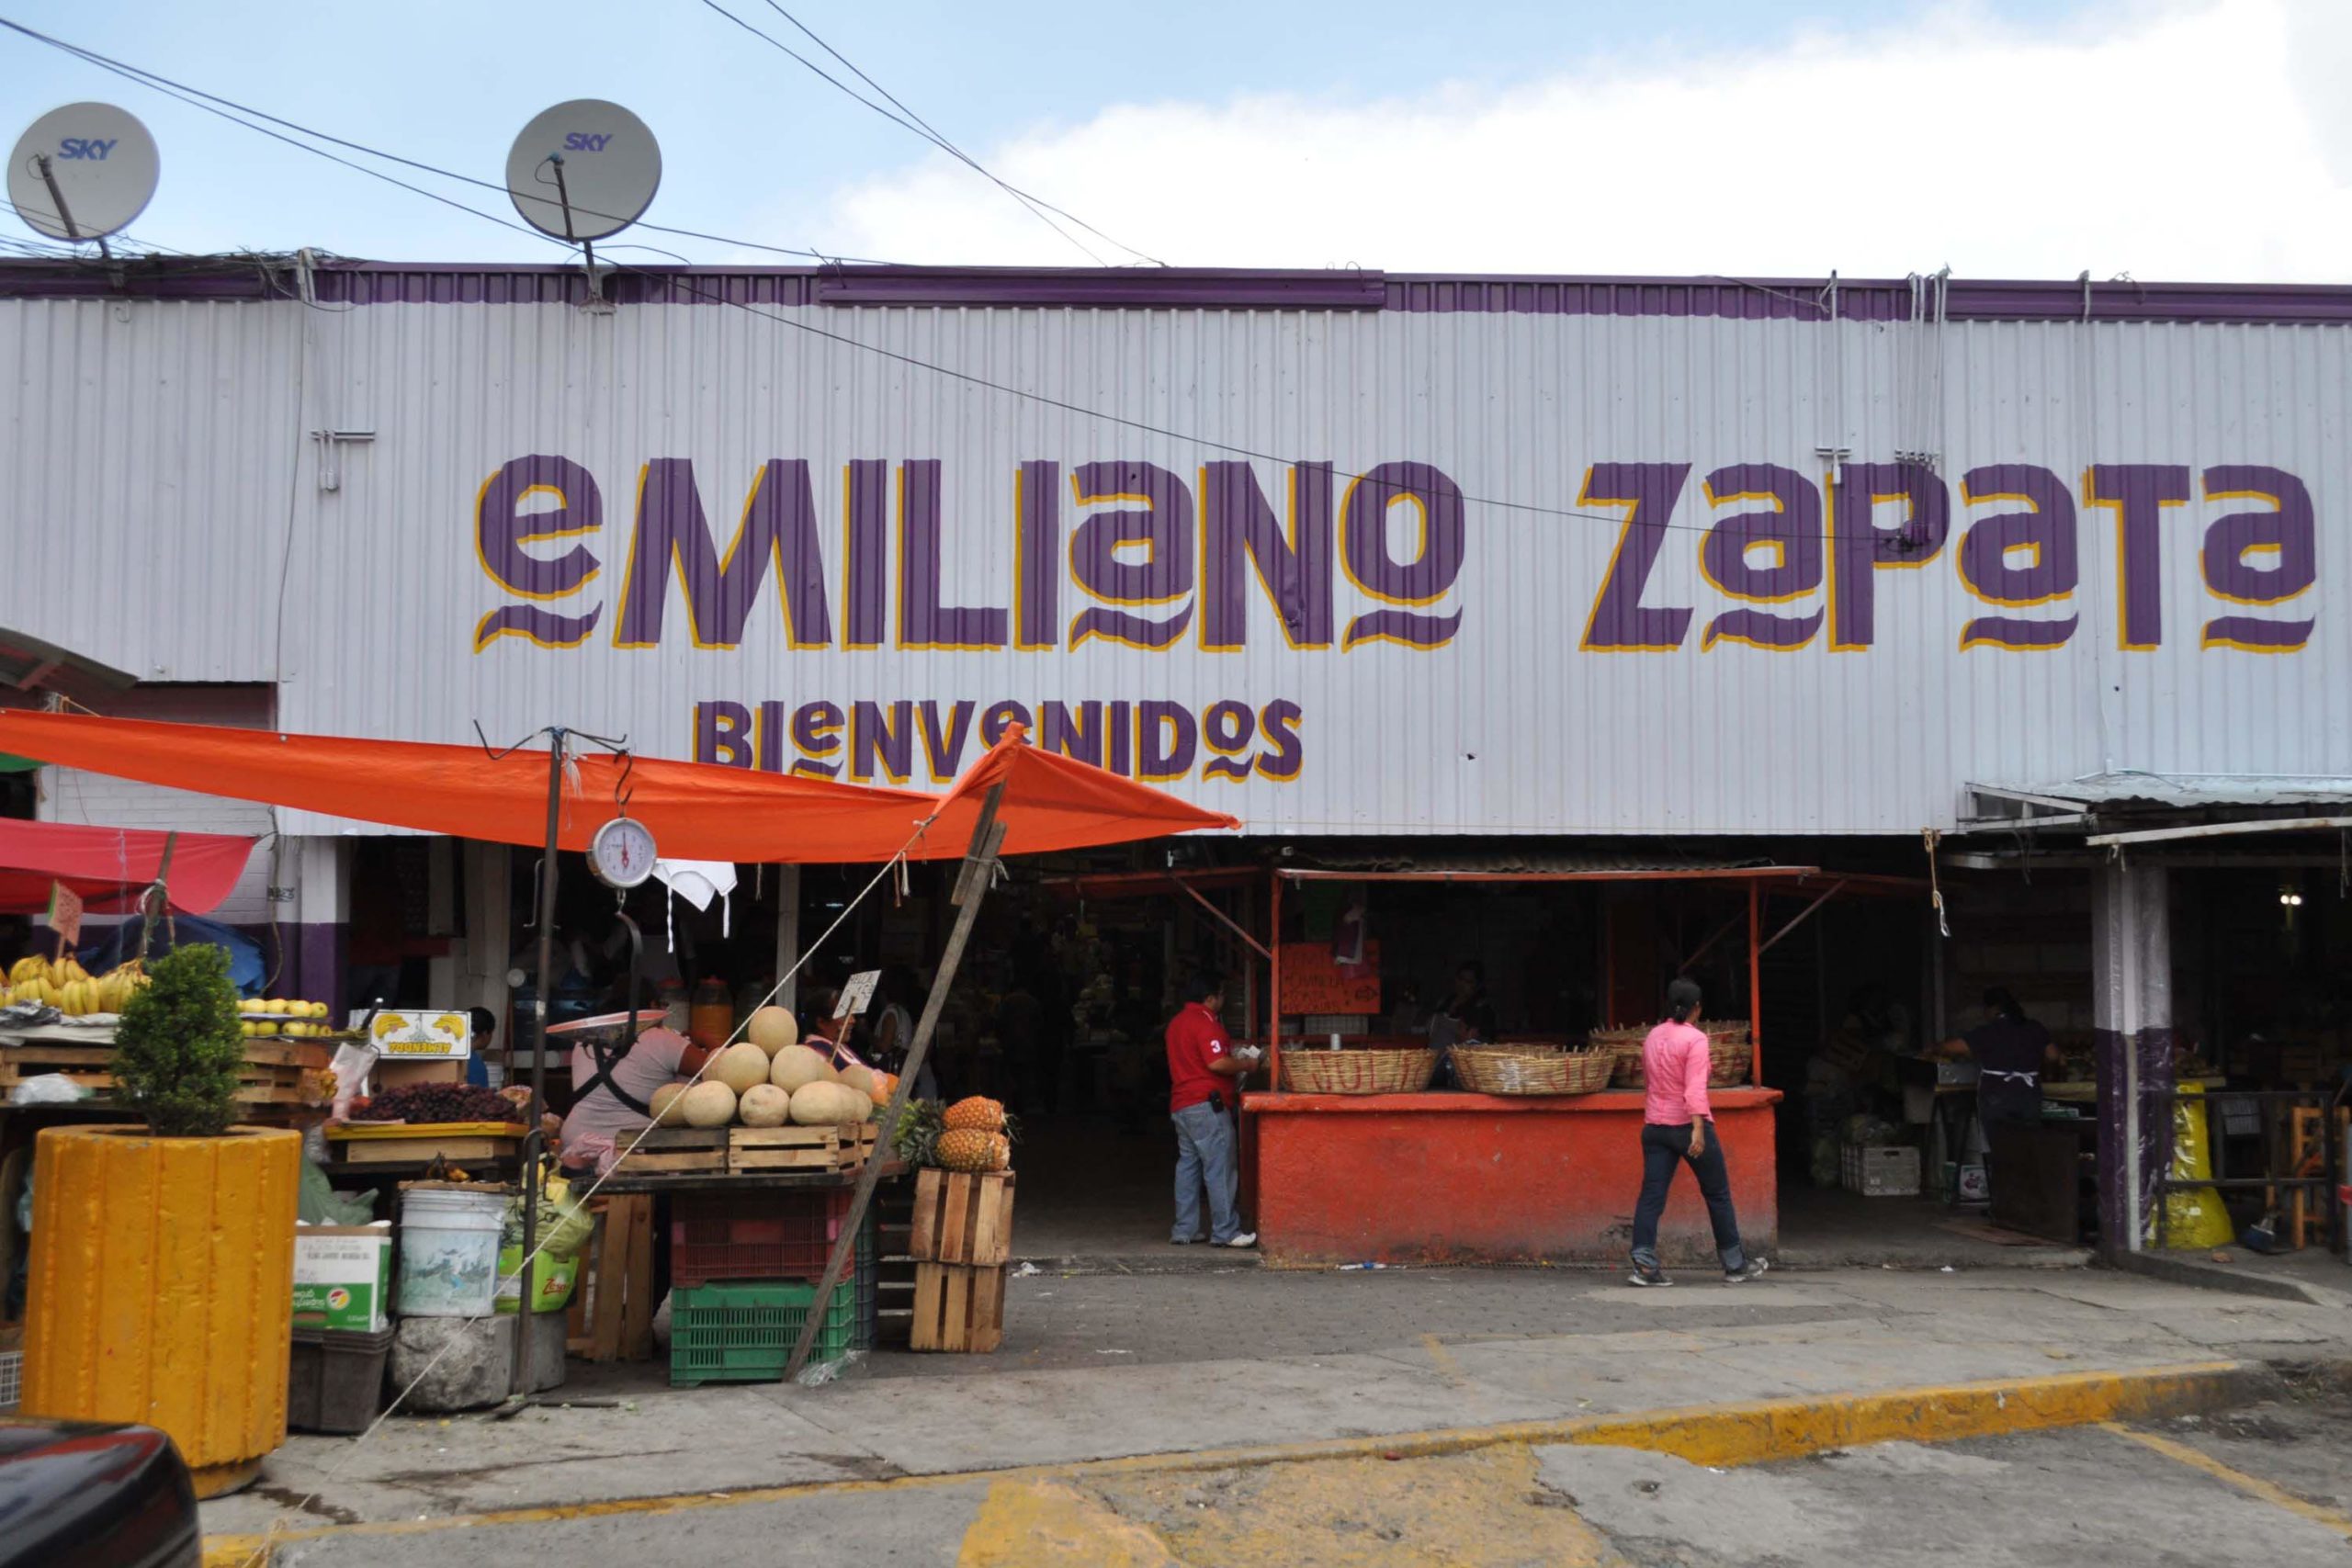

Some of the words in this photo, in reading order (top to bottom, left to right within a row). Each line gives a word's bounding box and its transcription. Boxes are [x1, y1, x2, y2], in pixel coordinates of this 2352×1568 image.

[59, 138, 119, 161] SKY
[563, 132, 614, 152] SKY
[1210, 1039, 1222, 1054] 3
